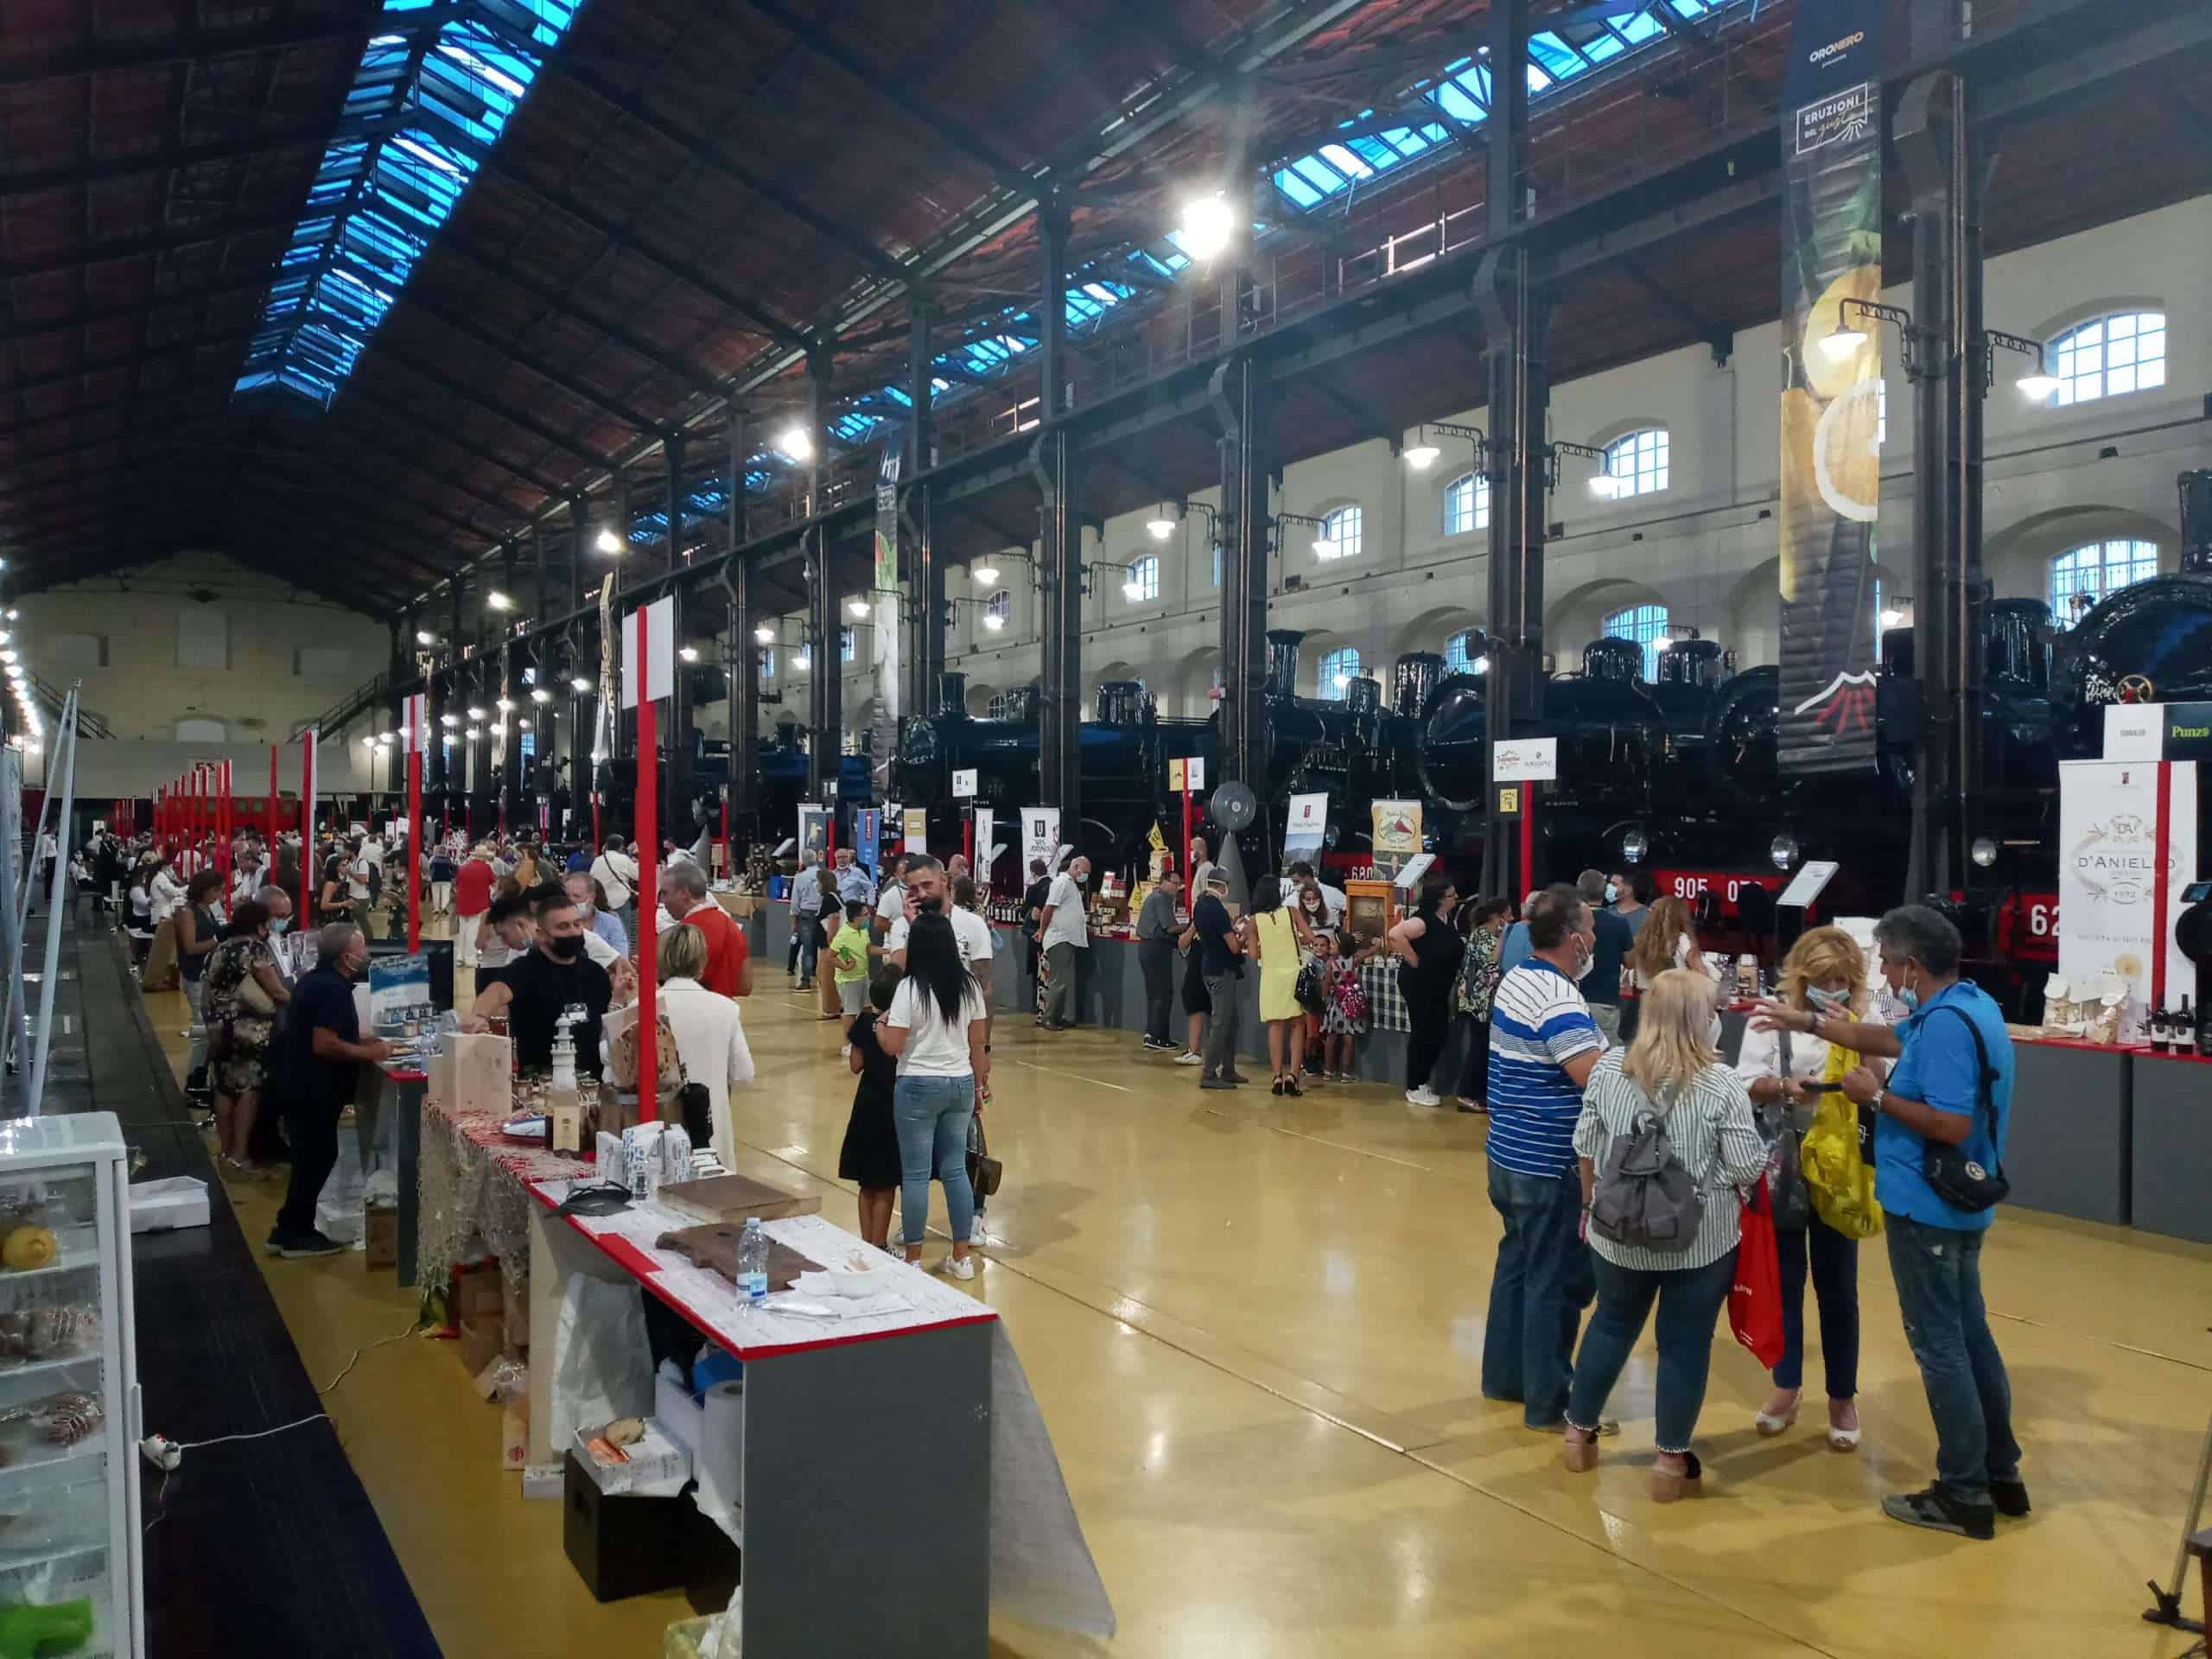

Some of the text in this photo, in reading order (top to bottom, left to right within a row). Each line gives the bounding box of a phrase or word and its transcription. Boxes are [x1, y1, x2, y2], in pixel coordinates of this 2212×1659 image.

[1809, 31, 1865, 63] ORONERO
[1804, 95, 1859, 125] ERUZIONI
[2078, 855, 2176, 869] D'ANIELO
